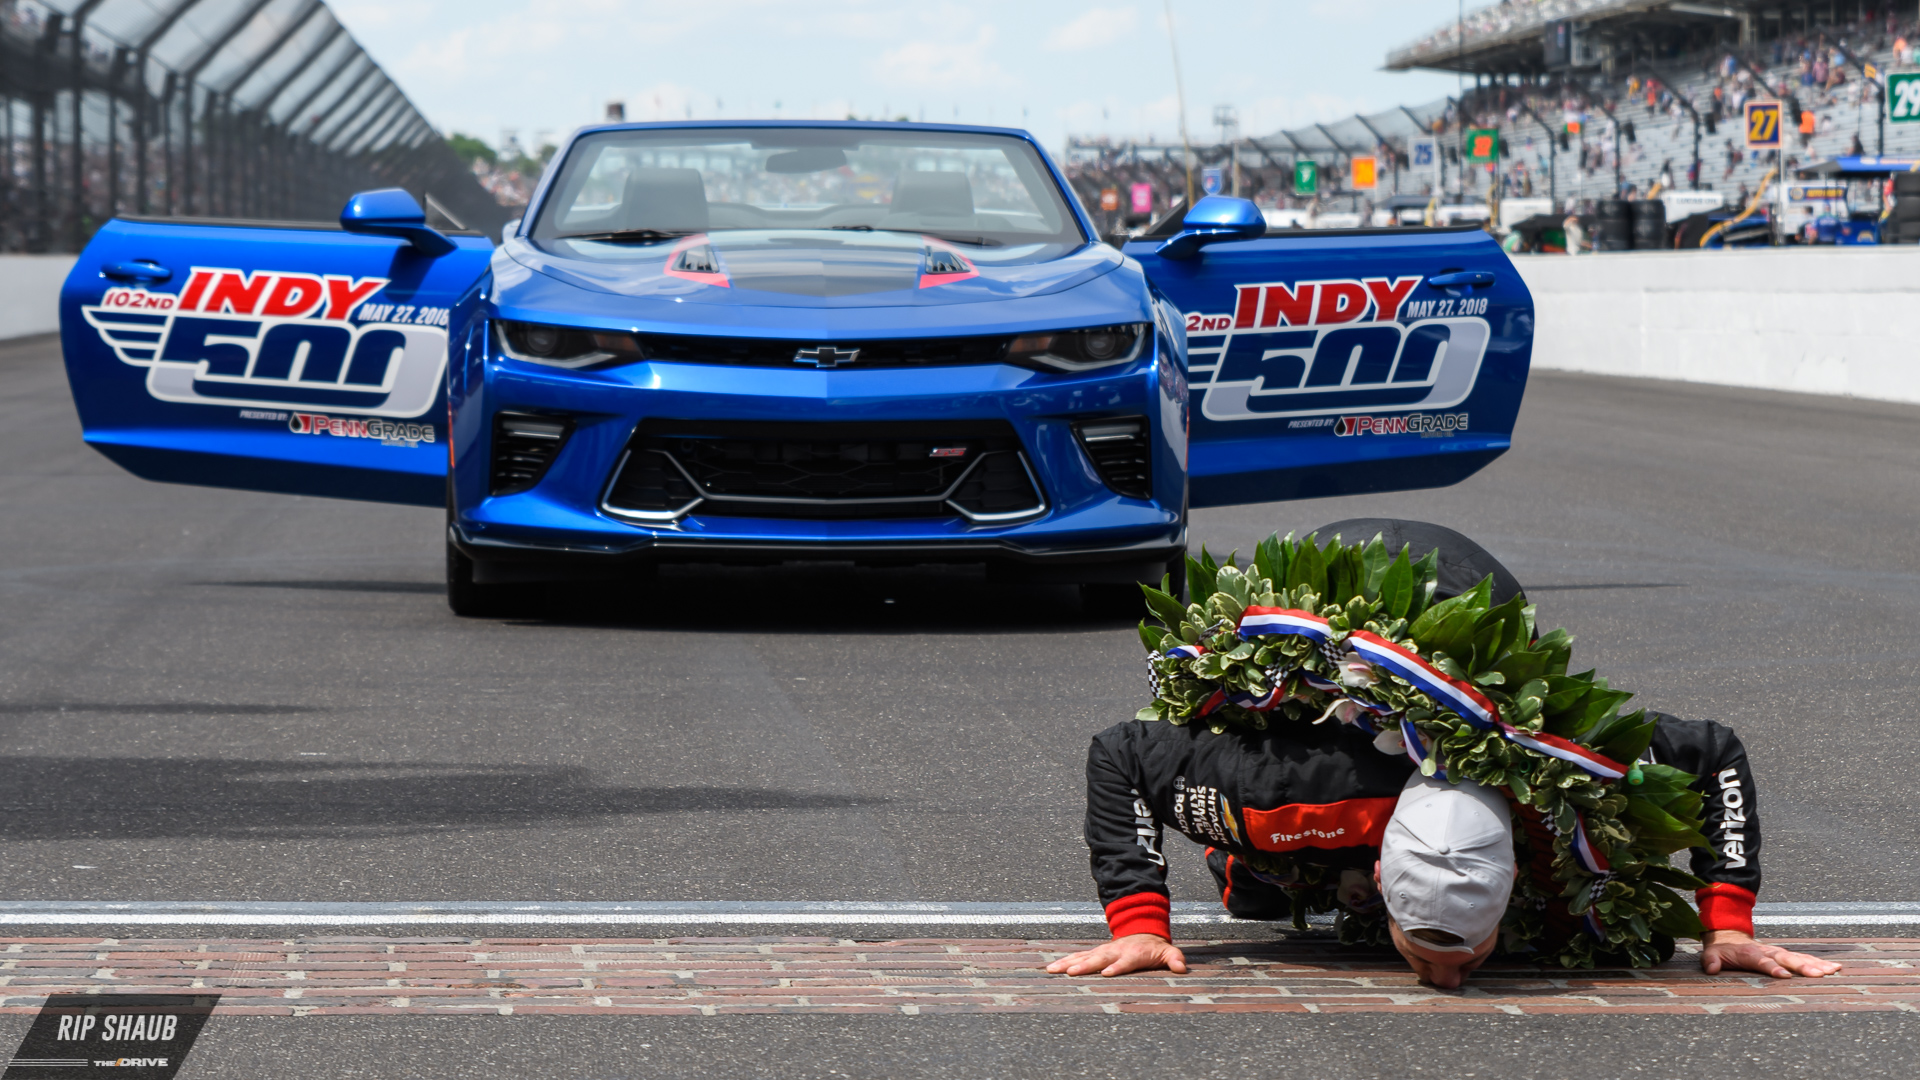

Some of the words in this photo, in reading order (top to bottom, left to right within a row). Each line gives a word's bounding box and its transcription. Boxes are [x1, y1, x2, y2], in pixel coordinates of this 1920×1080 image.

[1750, 109, 1778, 141] 27
[104, 291, 175, 310] 102ND
[178, 267, 390, 321] INDY
[358, 303, 396, 321] MAY
[1234, 276, 1422, 330] INDY
[1406, 300, 1437, 318] MAY
[1457, 297, 1489, 316] 2018
[147, 315, 448, 418] 500
[1202, 318, 1490, 421] 500
[239, 410, 276, 421] PRESENTED
[1288, 419, 1325, 429] PRESENTED
[1174, 793, 1191, 834] BOSCH
[1196, 785, 1219, 841] SIEMENS
[1207, 787, 1230, 845] HITACHI
[1718, 768, 1747, 869] verizon
[1270, 827, 1345, 844] Firestone
